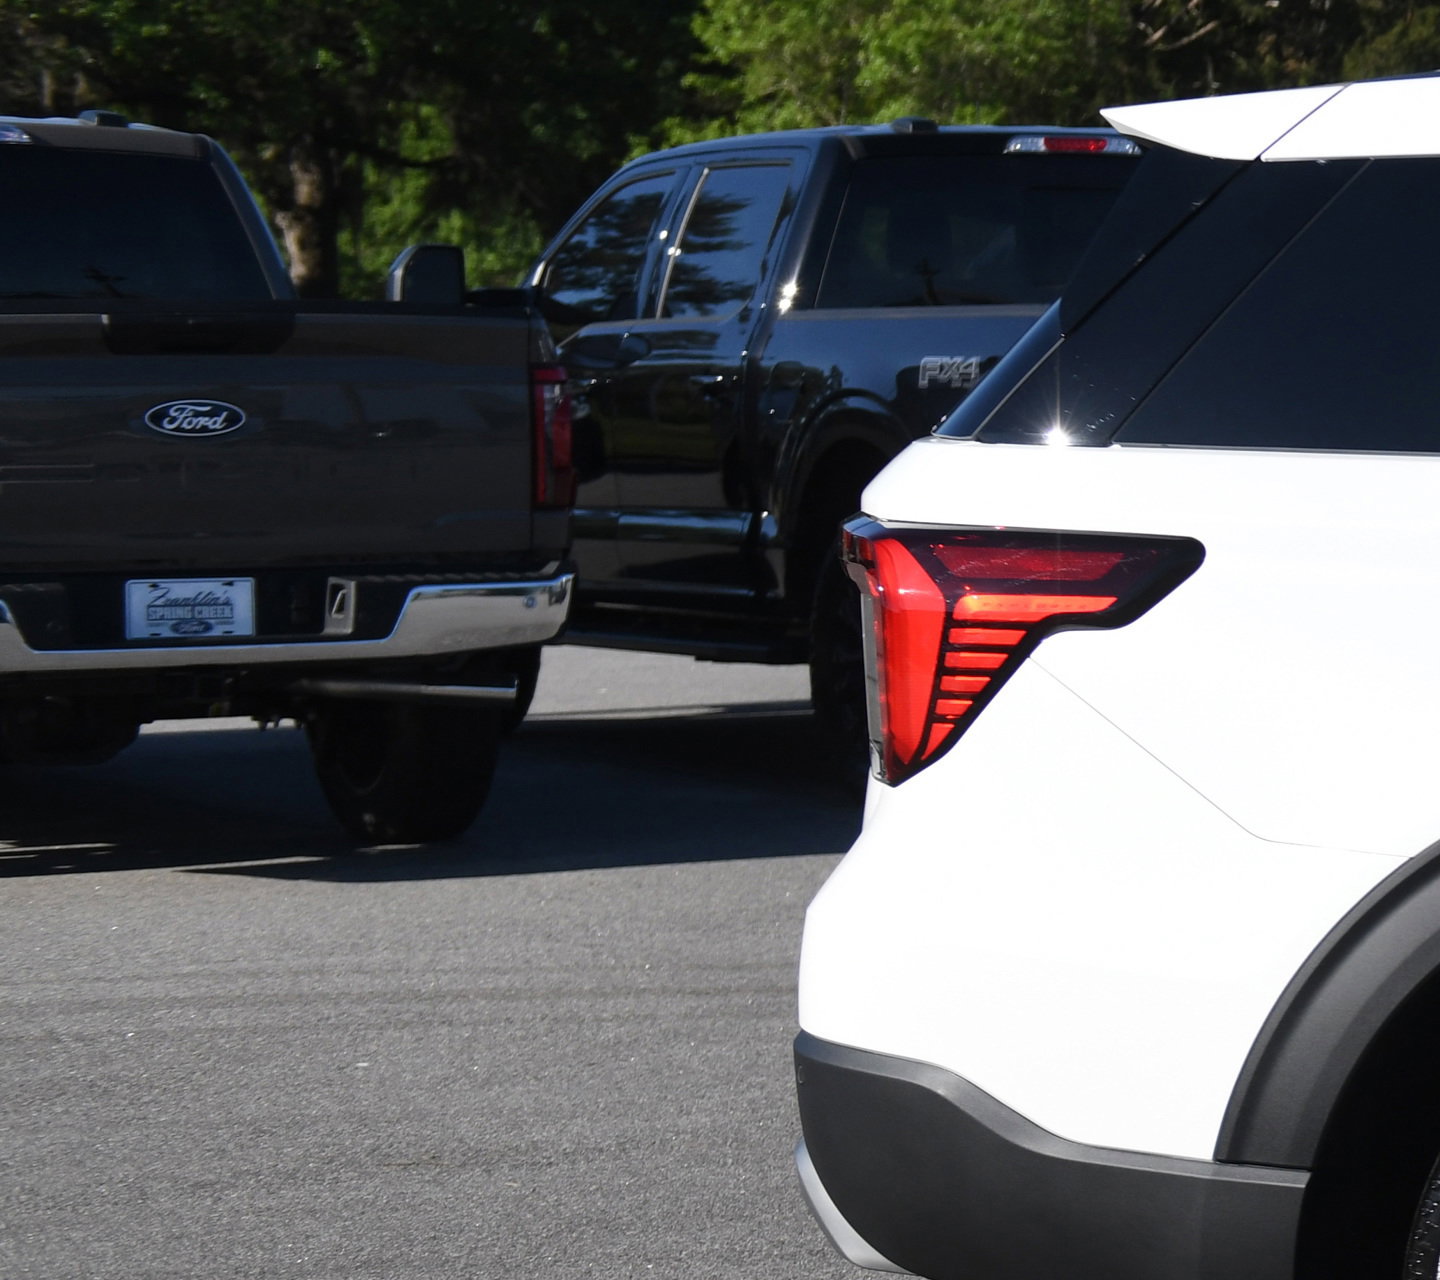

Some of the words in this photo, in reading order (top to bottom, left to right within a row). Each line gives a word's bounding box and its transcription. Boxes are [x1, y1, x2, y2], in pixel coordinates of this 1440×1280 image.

[163, 404, 229, 430] Ford
[148, 604, 193, 620] SPRING
[194, 604, 233, 619] CREEK
